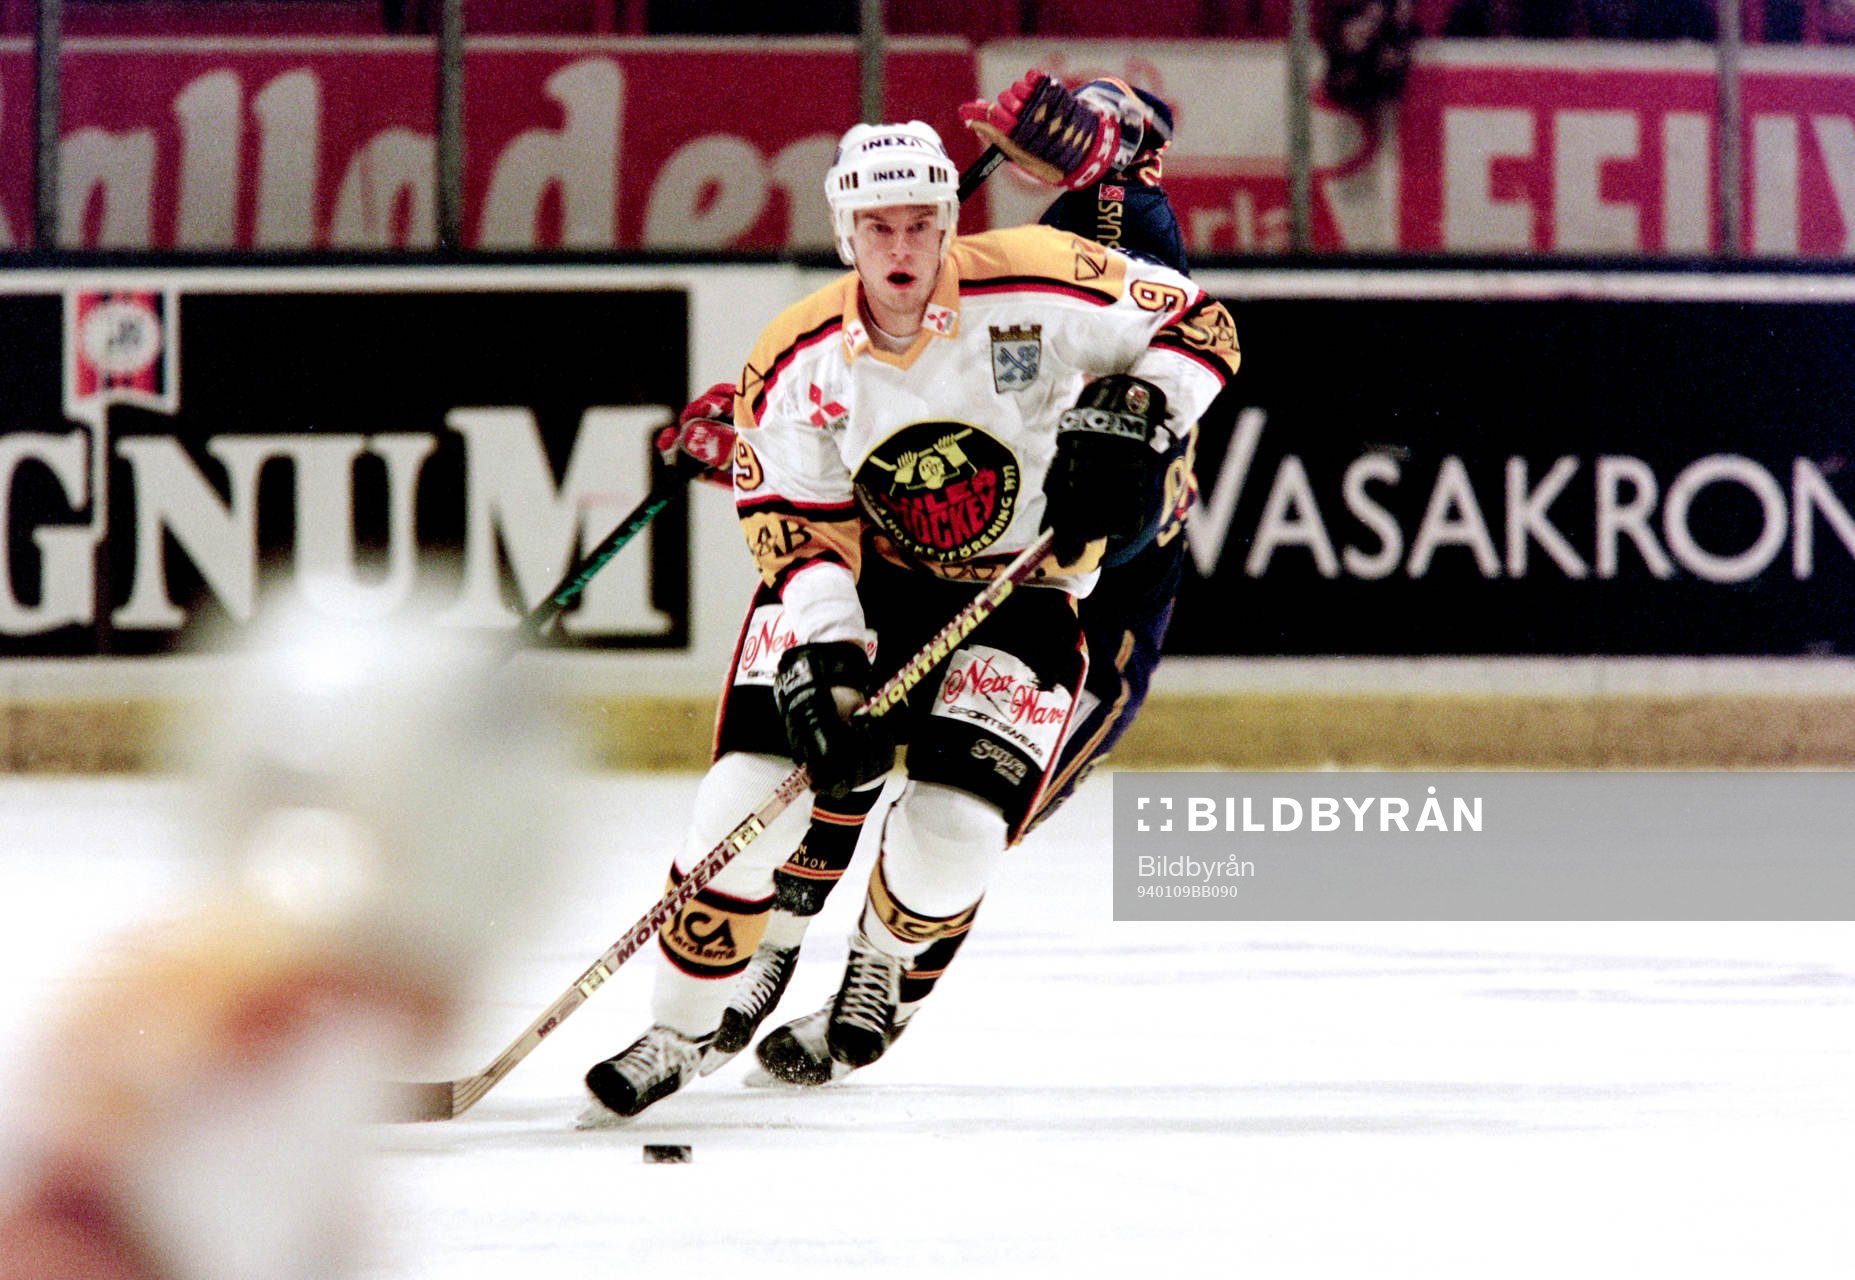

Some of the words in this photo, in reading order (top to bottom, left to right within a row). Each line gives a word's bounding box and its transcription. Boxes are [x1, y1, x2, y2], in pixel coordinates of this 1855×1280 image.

[862, 137, 922, 152] INEXA
[873, 168, 917, 182] INEXA
[735, 433, 765, 492] 9
[868, 604, 989, 717] MONTREAL
[943, 655, 1018, 705] New
[616, 847, 738, 966] MONTREAL
